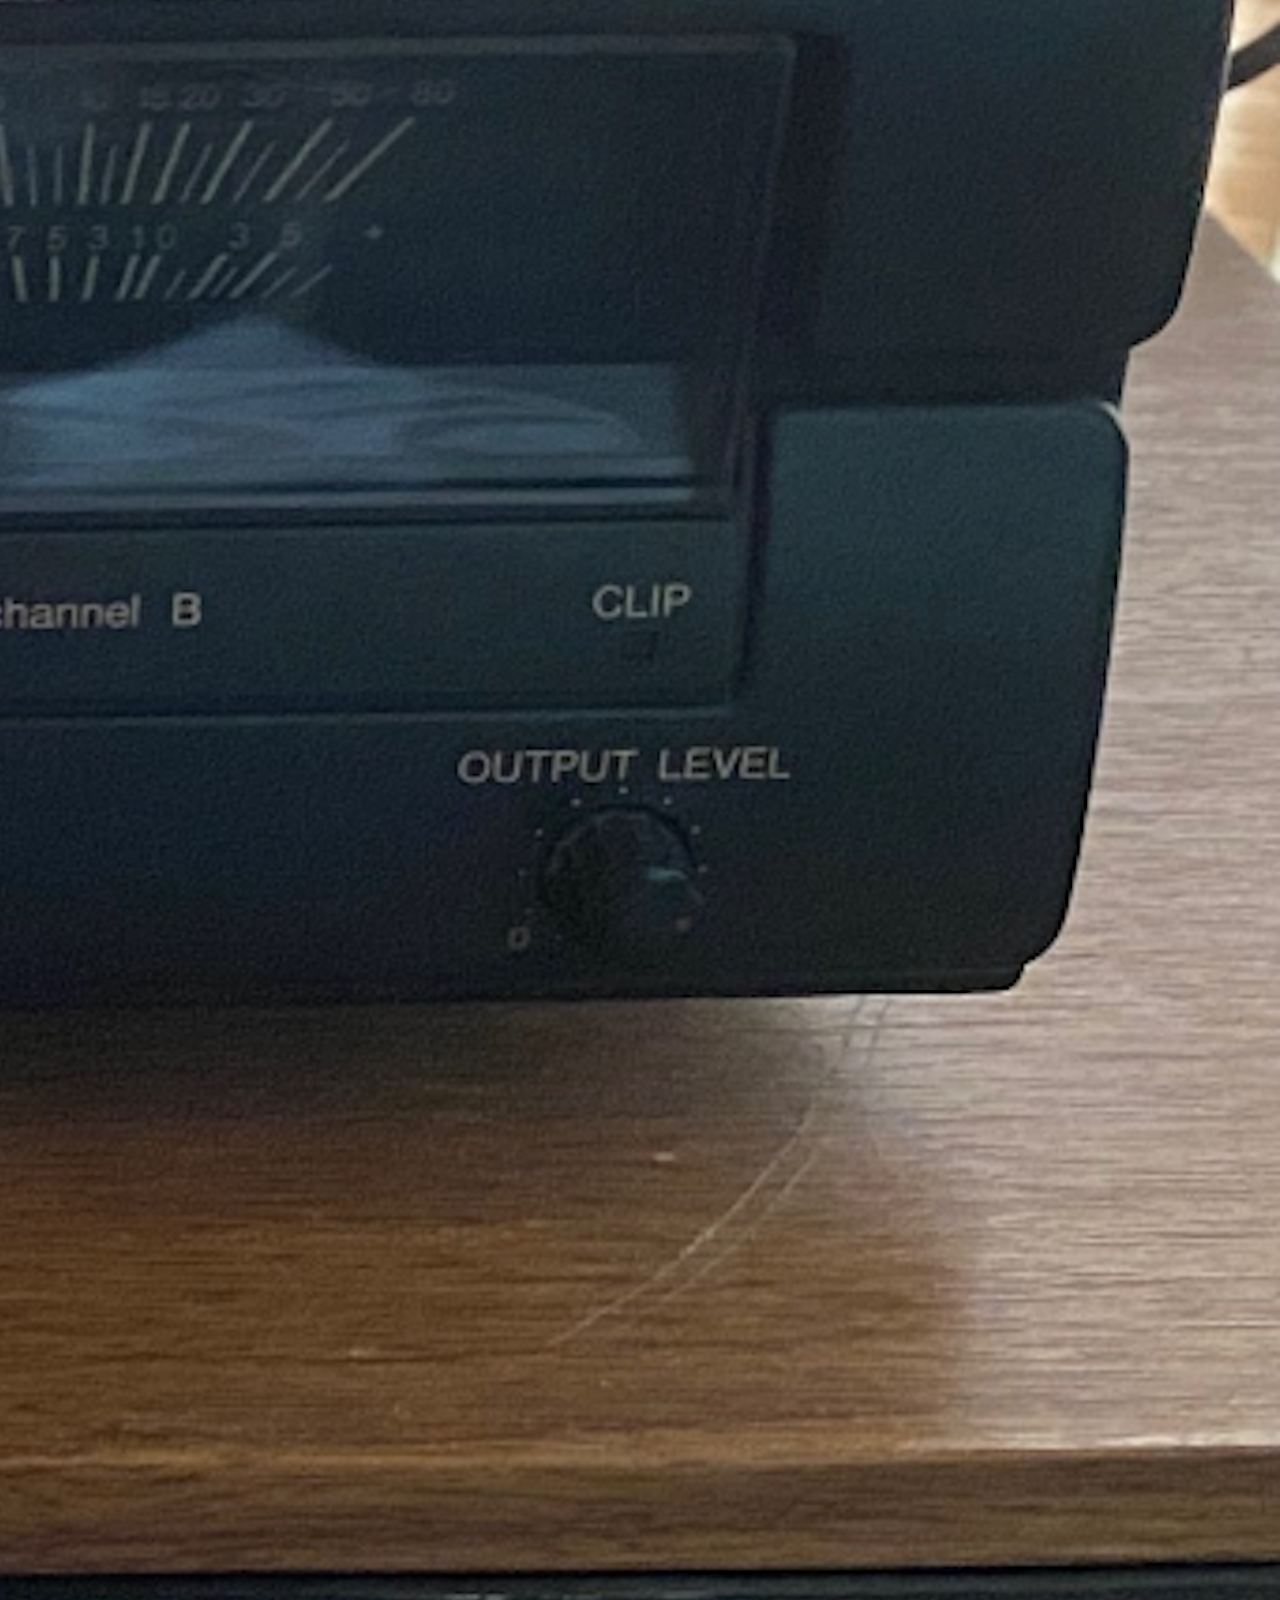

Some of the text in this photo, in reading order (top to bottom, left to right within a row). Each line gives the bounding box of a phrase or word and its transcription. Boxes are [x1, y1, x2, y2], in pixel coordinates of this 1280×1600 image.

[138, 84, 171, 111] 15
[178, 82, 222, 111] 20
[410, 78, 457, 107] 80
[8, 227, 26, 253] 7
[47, 227, 66, 252] 5
[91, 226, 111, 252] 3
[229, 224, 250, 250] 3
[282, 223, 302, 249] 5
[171, 592, 201, 628] B
[592, 584, 691, 620] CLIP
[457, 745, 792, 786] OUTPUT LEVEL
[506, 925, 531, 951] 0
